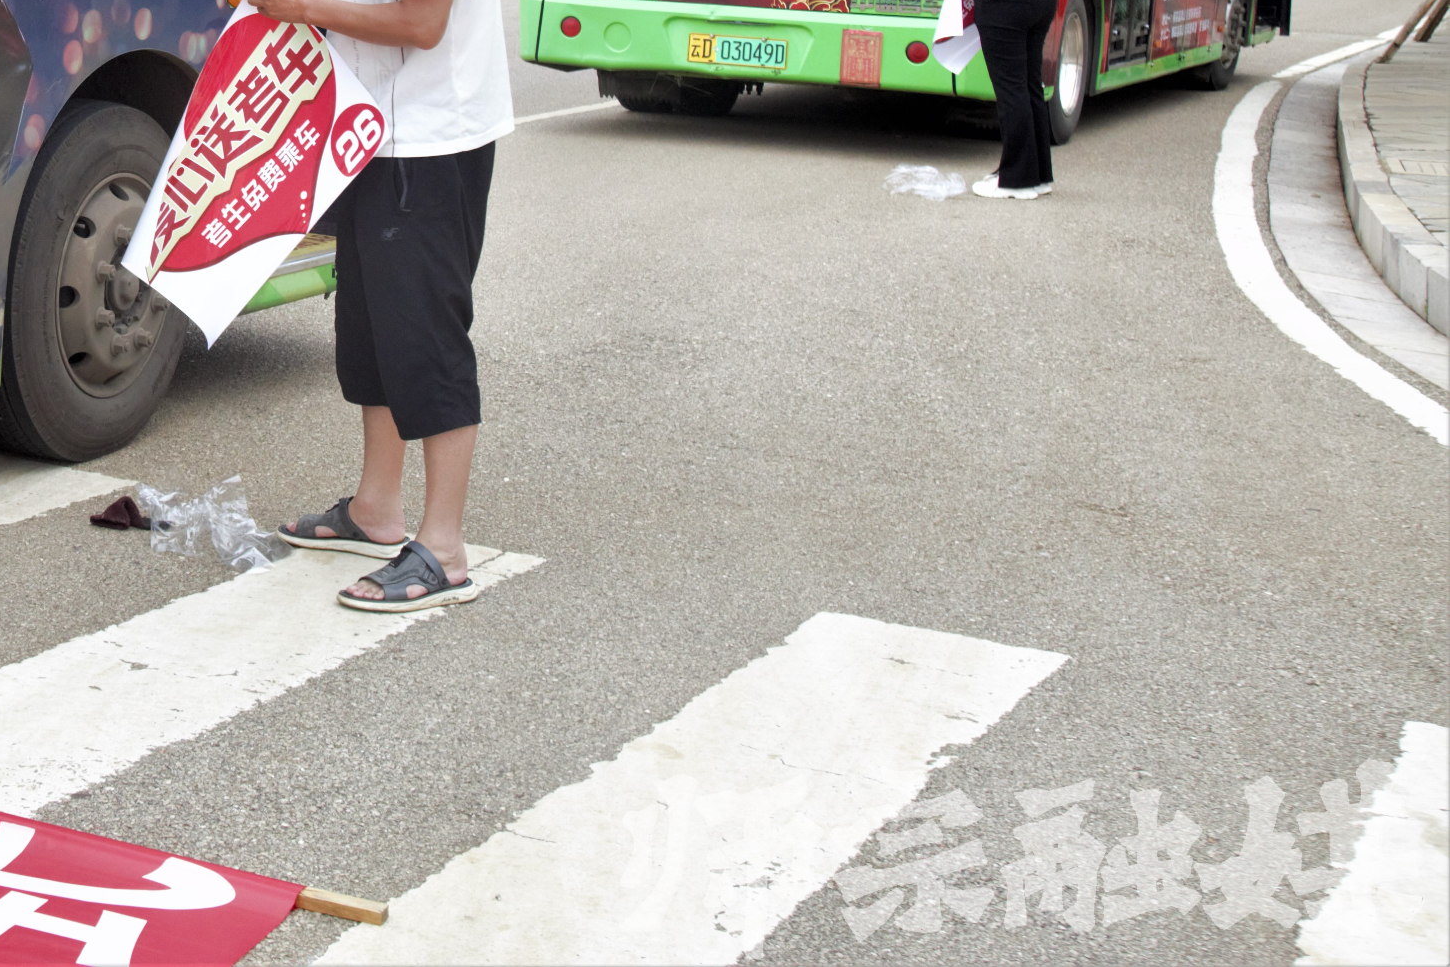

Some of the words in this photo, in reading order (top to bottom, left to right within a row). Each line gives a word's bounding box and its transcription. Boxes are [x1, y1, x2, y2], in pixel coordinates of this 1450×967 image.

[201, 119, 321, 249] 考生免费乘车
[335, 108, 382, 174] 26
